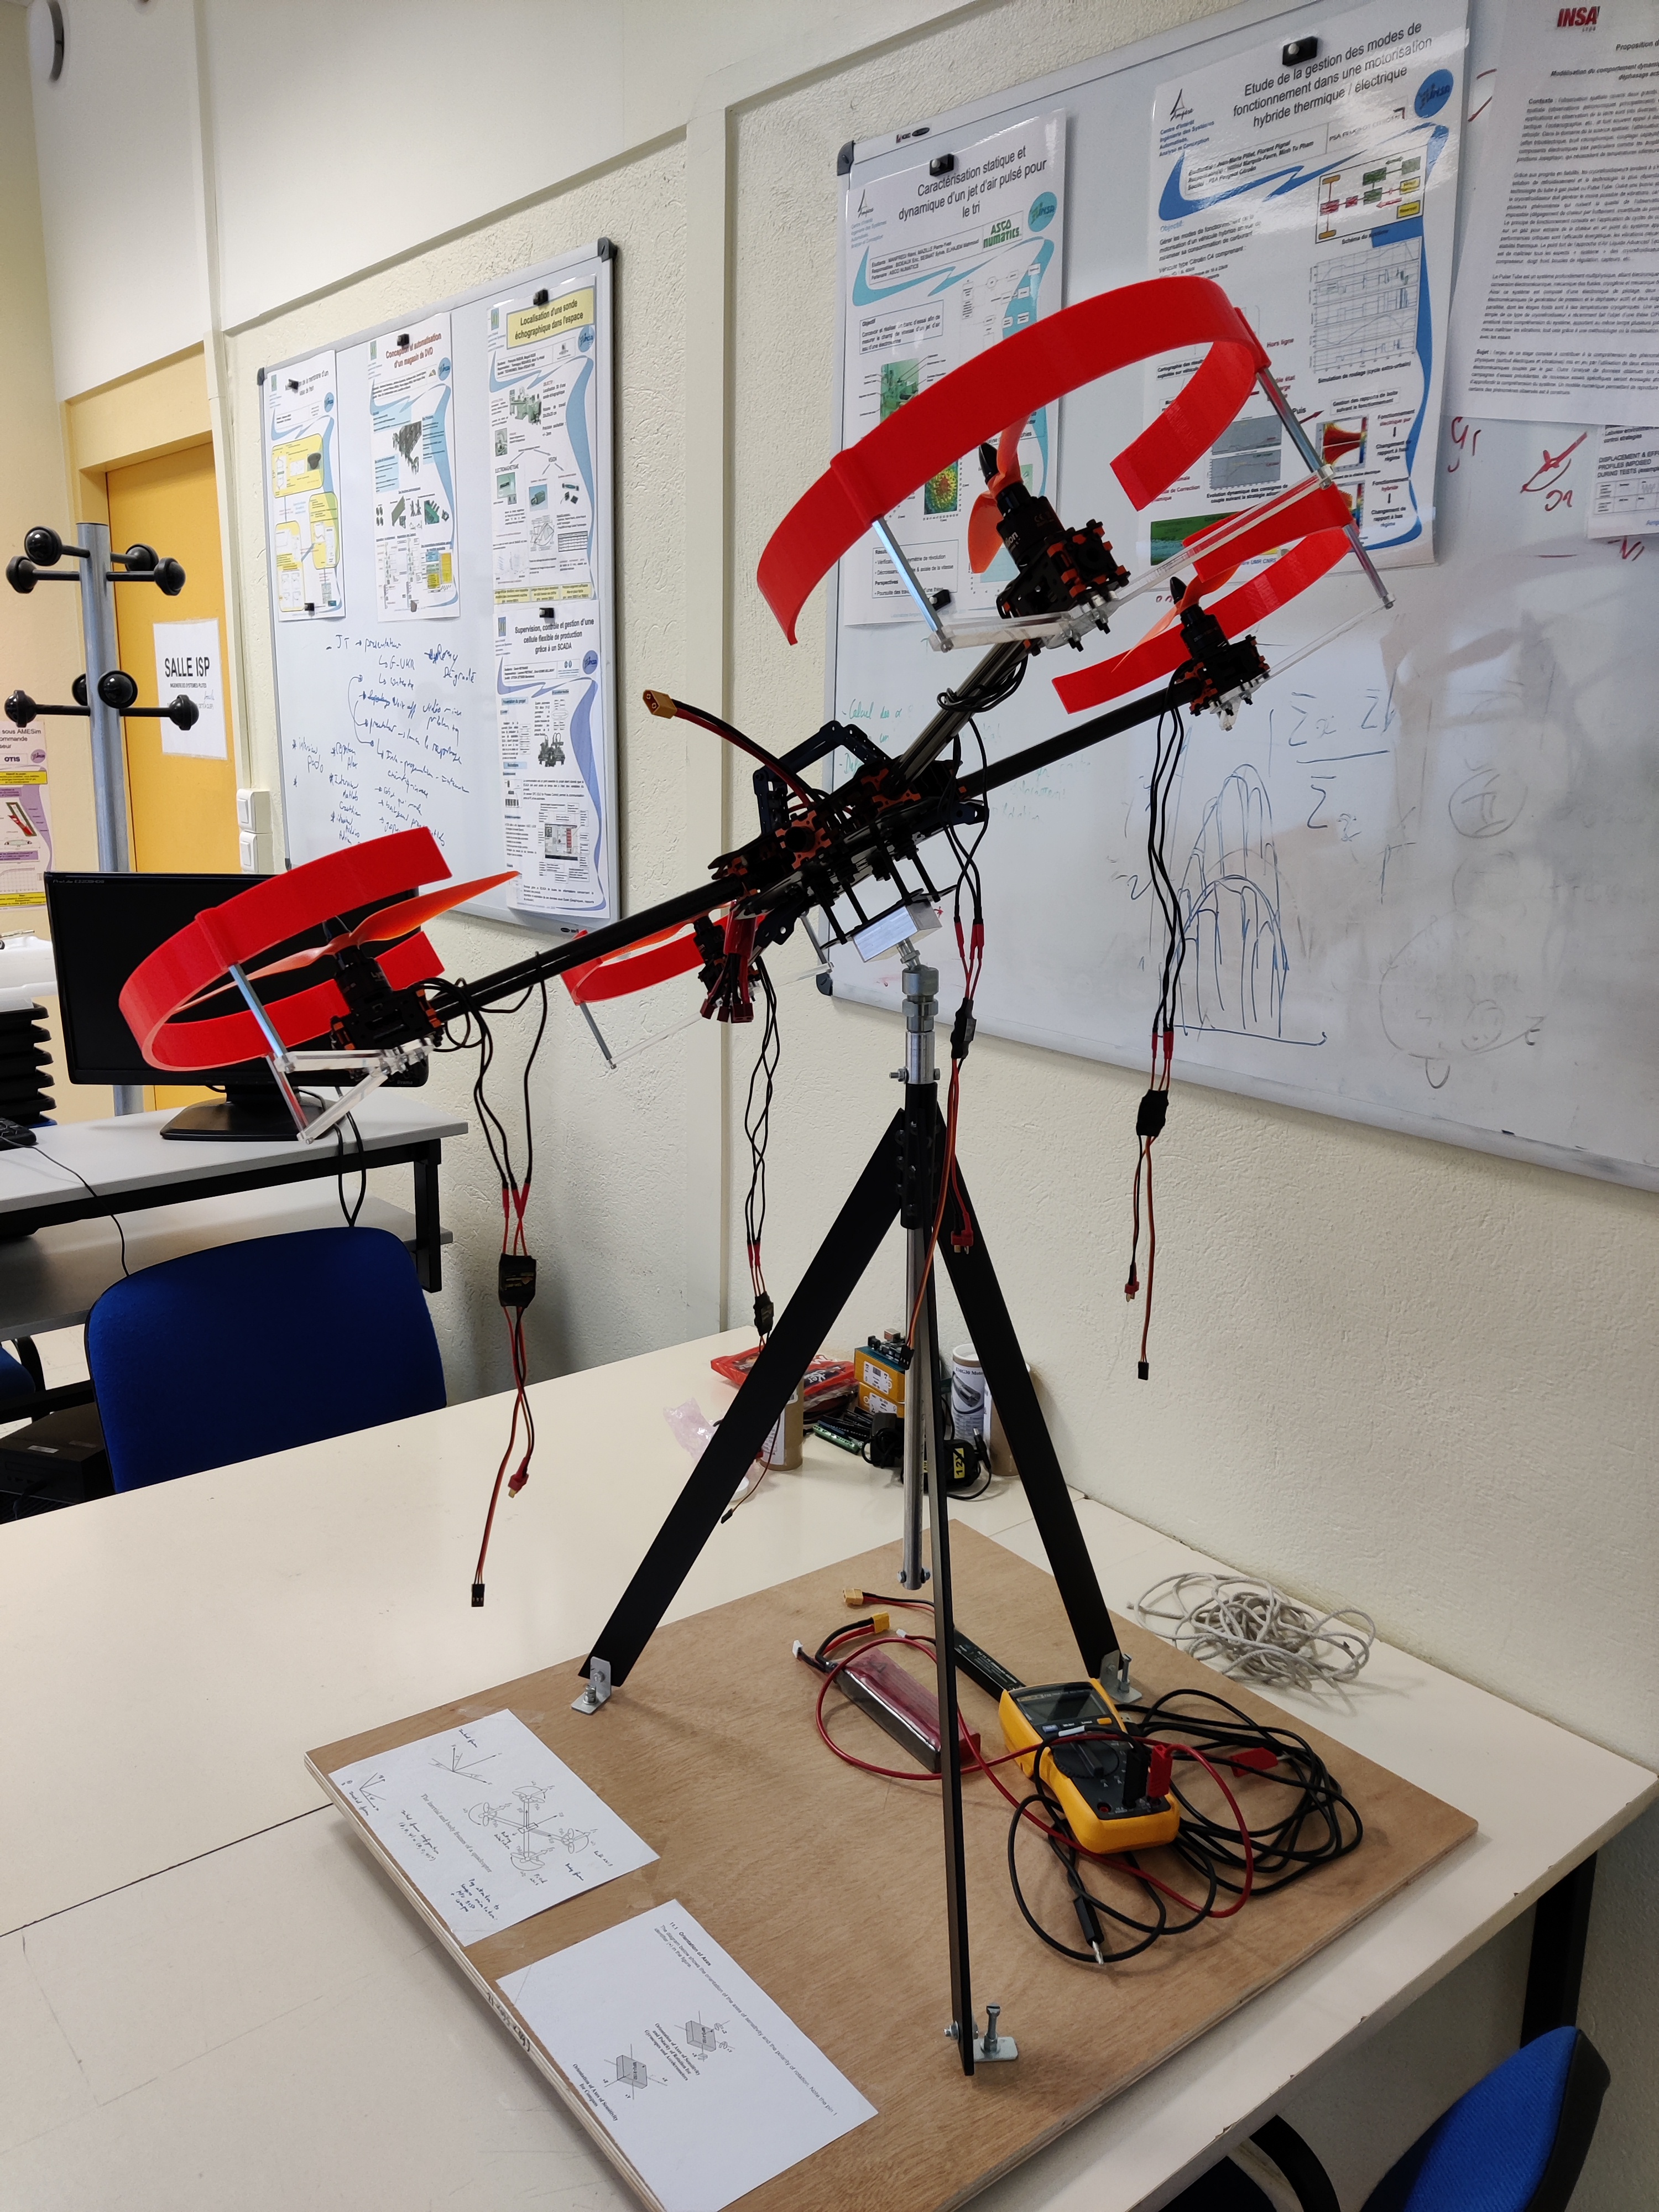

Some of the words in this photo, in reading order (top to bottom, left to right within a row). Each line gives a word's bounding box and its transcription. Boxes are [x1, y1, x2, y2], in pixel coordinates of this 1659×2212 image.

[1557, 6, 1599, 27] INSA
[1245, 79, 1274, 96] Etude
[1277, 67, 1291, 85] de
[1293, 62, 1303, 80] la
[1305, 54, 1342, 77] gestion
[1345, 45, 1364, 60] des
[1368, 30, 1404, 52] modes
[1408, 23, 1421, 35] de
[1616, 41, 1653, 51] Proposition
[1234, 81, 1311, 116] fonctionnement
[1314, 74, 1339, 89] dans
[1343, 65, 1361, 79] une
[1365, 35, 1432, 71] motorisation
[1254, 107, 1291, 128] hybride
[1294, 89, 1345, 114] thermique
[1355, 67, 1407, 93] électrique
[918, 167, 980, 196] Caractérisation
[983, 153, 1015, 174] statique
[1018, 145, 1026, 159] et
[899, 198, 945, 221] dynamique
[947, 191, 965, 205] d'un
[968, 184, 978, 200] jet
[980, 177, 998, 193] d'air
[1000, 166, 1022, 188] pulsé
[1025, 160, 1047, 179] pour
[963, 206, 969, 218] le
[991, 219, 1011, 234] ASCO
[515, 324, 551, 340] échographique
[552, 319, 562, 328] dans
[563, 312, 583, 324] l'espace
[520, 309, 550, 326] Localisation
[551, 306, 562, 316] d'une
[563, 299, 577, 311] sonde
[404, 353, 419, 365] magasin
[425, 347, 433, 357] DVD
[1598, 462, 1624, 470] PROFILES
[515, 625, 541, 634] Supervision,
[542, 622, 559, 630] contrôle
[565, 620, 580, 629] gestion
[560, 630, 582, 640] production
[535, 645, 546, 654] grâce
[165, 657, 193, 677] SALLE
[196, 656, 210, 677] ISP
[421, 1793, 429, 1802] The
[427, 1802, 442, 1815] inertial
[446, 1822, 456, 1832] body
[453, 1832, 466, 1844] frames
[679, 1932, 698, 1952] Orientation
[701, 1957, 711, 1966] Axes
[666, 1933, 680, 1946] diagram
[679, 1945, 690, 1956] below
[688, 1957, 700, 1968] shows
[705, 1974, 723, 1992] orientation
[732, 2004, 742, 2013] axes
[745, 2017, 763, 2036] sensitivity
[775, 2051, 791, 2065] polarity
[794, 2070, 809, 2086] rotation.
[810, 2086, 820, 2098] Note
[645, 2030, 661, 2048] Gyroscopes
[667, 2056, 688, 2080] Accelerometers
[655, 2023, 671, 2042] Orientation
[684, 2058, 700, 2075] Sensitivity
[673, 2054, 686, 2069] Rotation
[573, 2064, 589, 2085] Orientation
[602, 2102, 618, 2121] Sensitivity
[585, 2090, 598, 2106] Compass
